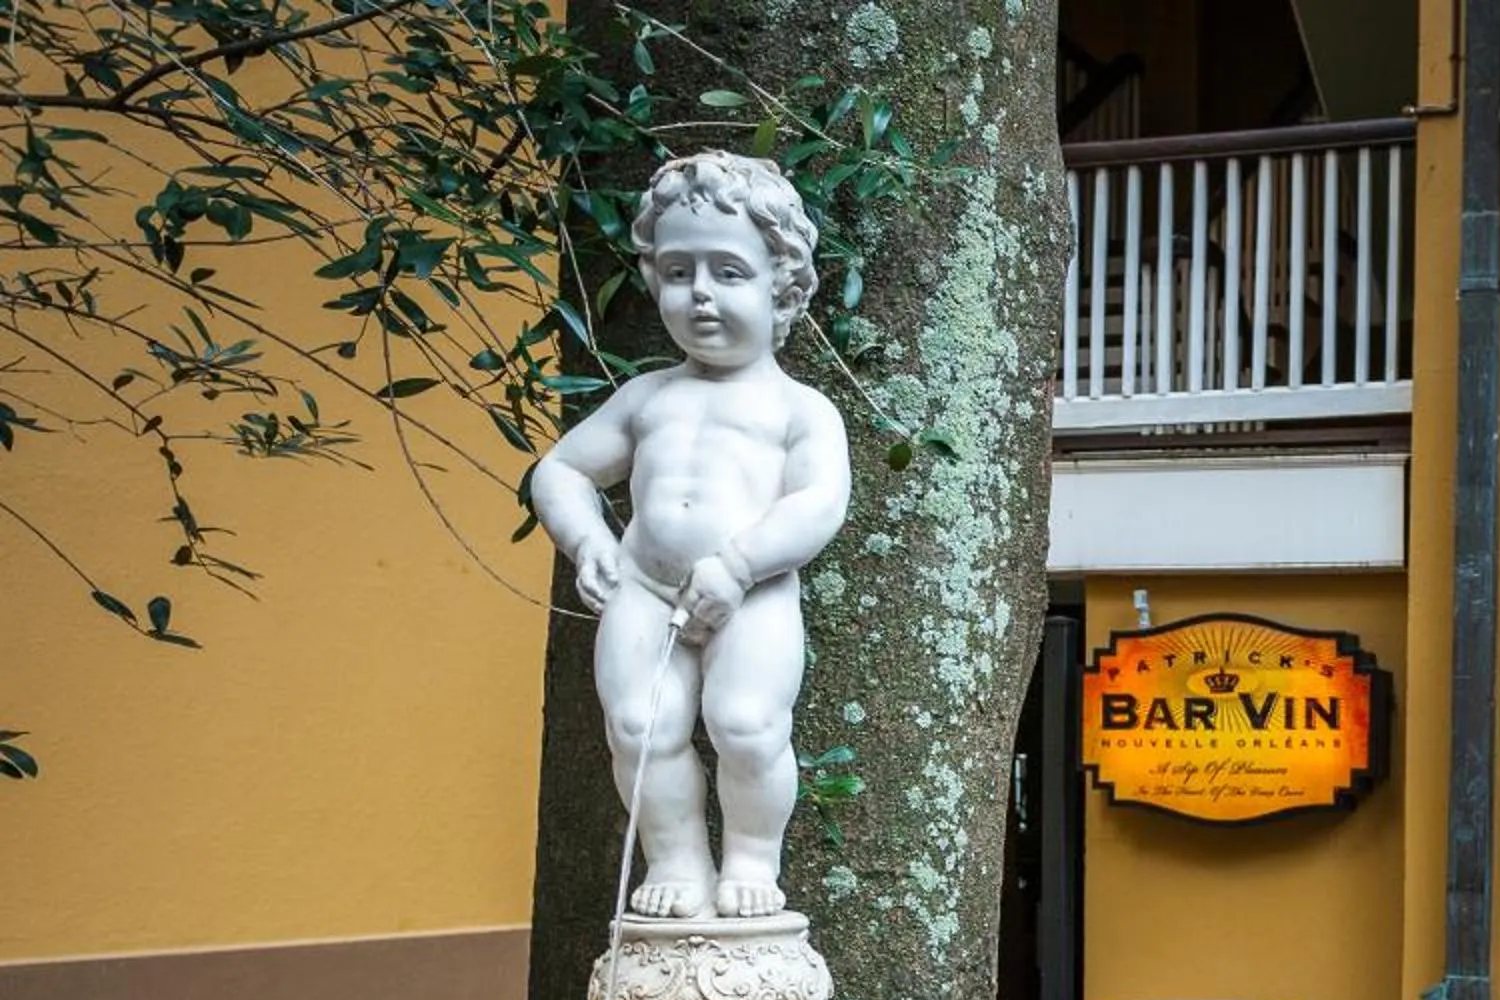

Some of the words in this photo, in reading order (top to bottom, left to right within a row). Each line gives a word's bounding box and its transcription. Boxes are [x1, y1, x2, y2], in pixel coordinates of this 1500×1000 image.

[1106, 649, 1336, 682] PATRICK'S
[1101, 693, 1216, 731] BAR
[1238, 692, 1342, 731] VIN
[1101, 738, 1218, 749] NOUVELLE
[1236, 735, 1342, 749] ORLÉANS
[1149, 760, 1171, 775] A
[1204, 757, 1231, 784] Of
